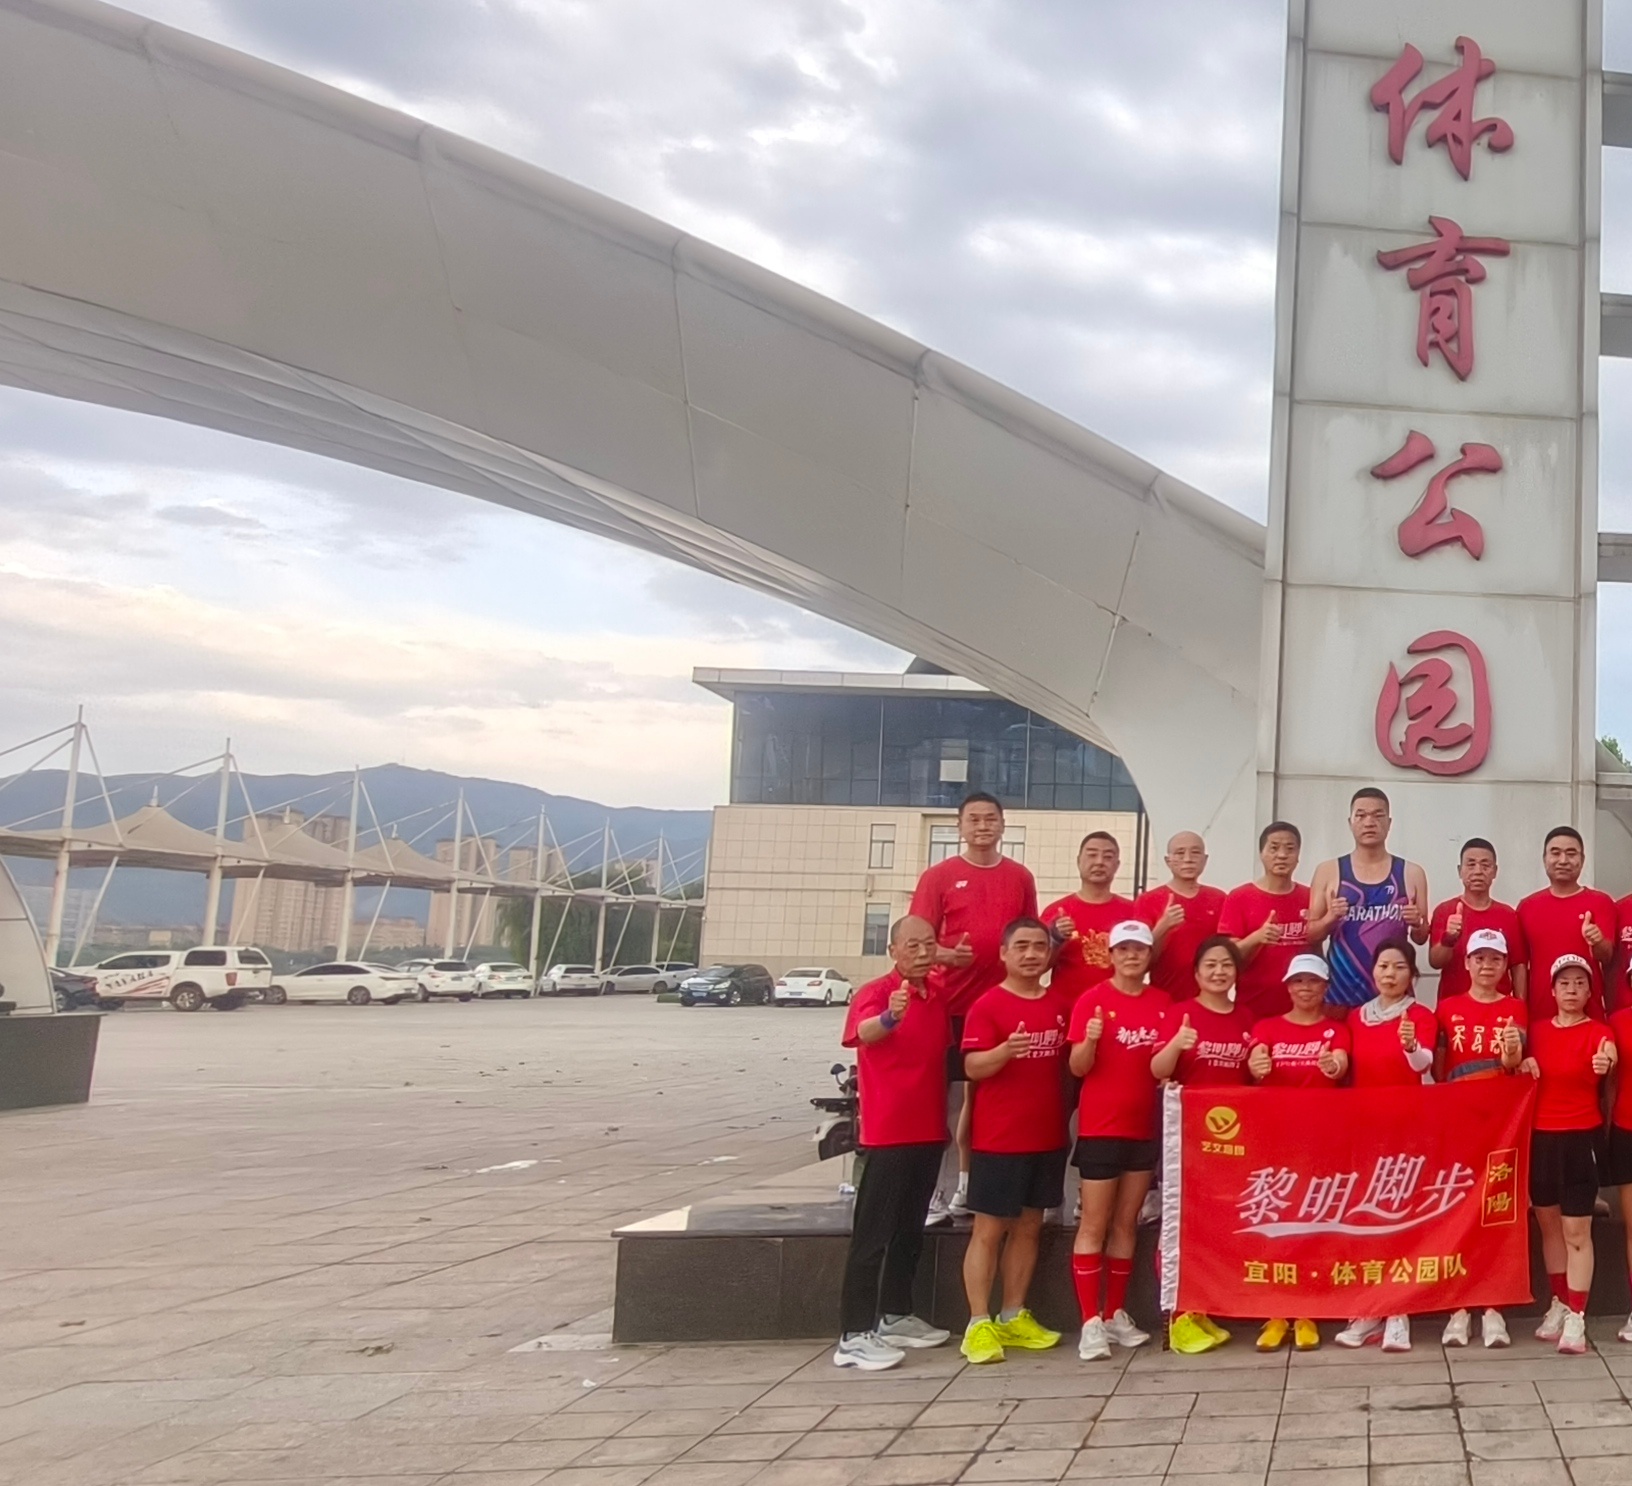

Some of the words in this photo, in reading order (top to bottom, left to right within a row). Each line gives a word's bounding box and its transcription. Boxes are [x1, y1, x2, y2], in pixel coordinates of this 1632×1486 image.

[1369, 35, 1515, 775] 体育公园
[1343, 903, 1405, 922] ARATHO
[1234, 1153, 1476, 1234] 黎明脚步
